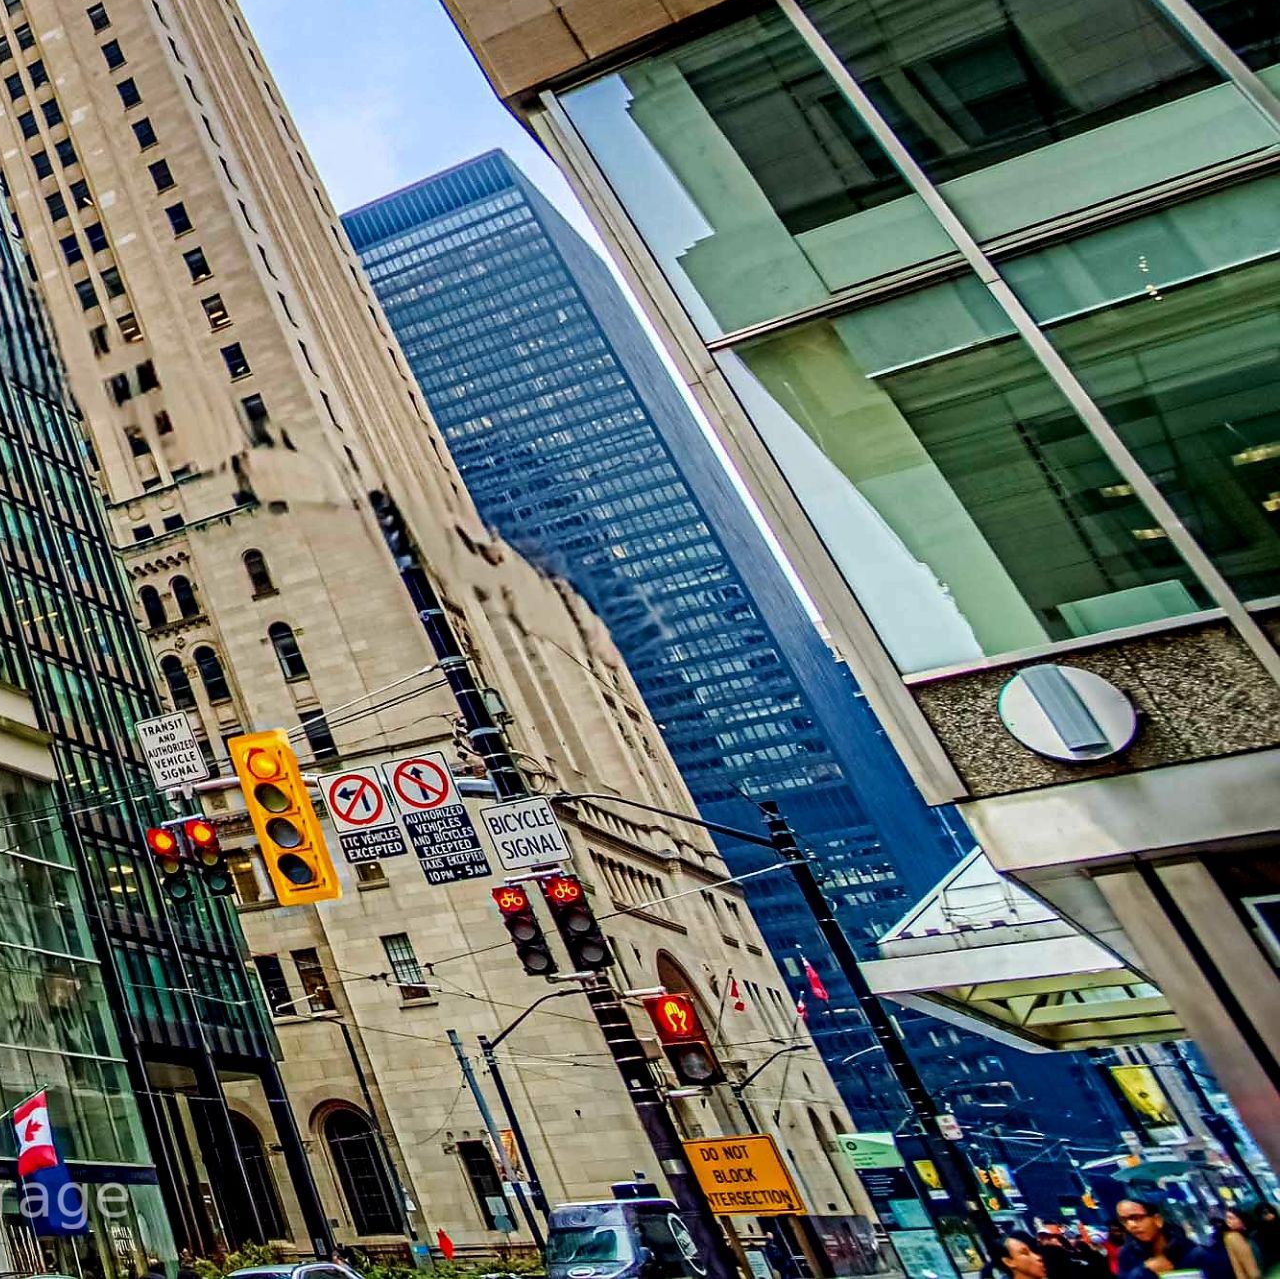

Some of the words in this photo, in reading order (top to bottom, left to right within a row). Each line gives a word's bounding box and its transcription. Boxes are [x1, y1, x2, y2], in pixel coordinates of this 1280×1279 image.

[142, 718, 184, 737] TRANSIT
[159, 733, 176, 743] AND
[148, 739, 195, 758] AUTHORIZED
[154, 751, 196, 769] VEHICLE
[161, 764, 199, 781] SIGNAL
[405, 805, 464, 825] AUTHORIZED
[488, 807, 554, 835] BICYCLE
[415, 817, 462, 834] VEHICLES
[342, 836, 360, 848] TTC
[361, 829, 401, 845] VEHICLES
[413, 835, 431, 847] AND
[433, 826, 474, 843] BICYCLES
[348, 842, 403, 860] EXCEPTED
[423, 839, 472, 857] EXCEPTED
[501, 833, 562, 860] SIGNAL
[421, 858, 445, 871] TAXIS
[446, 851, 486, 866] EXCEPTED
[699, 1147, 719, 1162] DO
[722, 1145, 750, 1160] NOT
[712, 1168, 758, 1184] BLOCK
[707, 1189, 793, 1208] NTERSECTION
